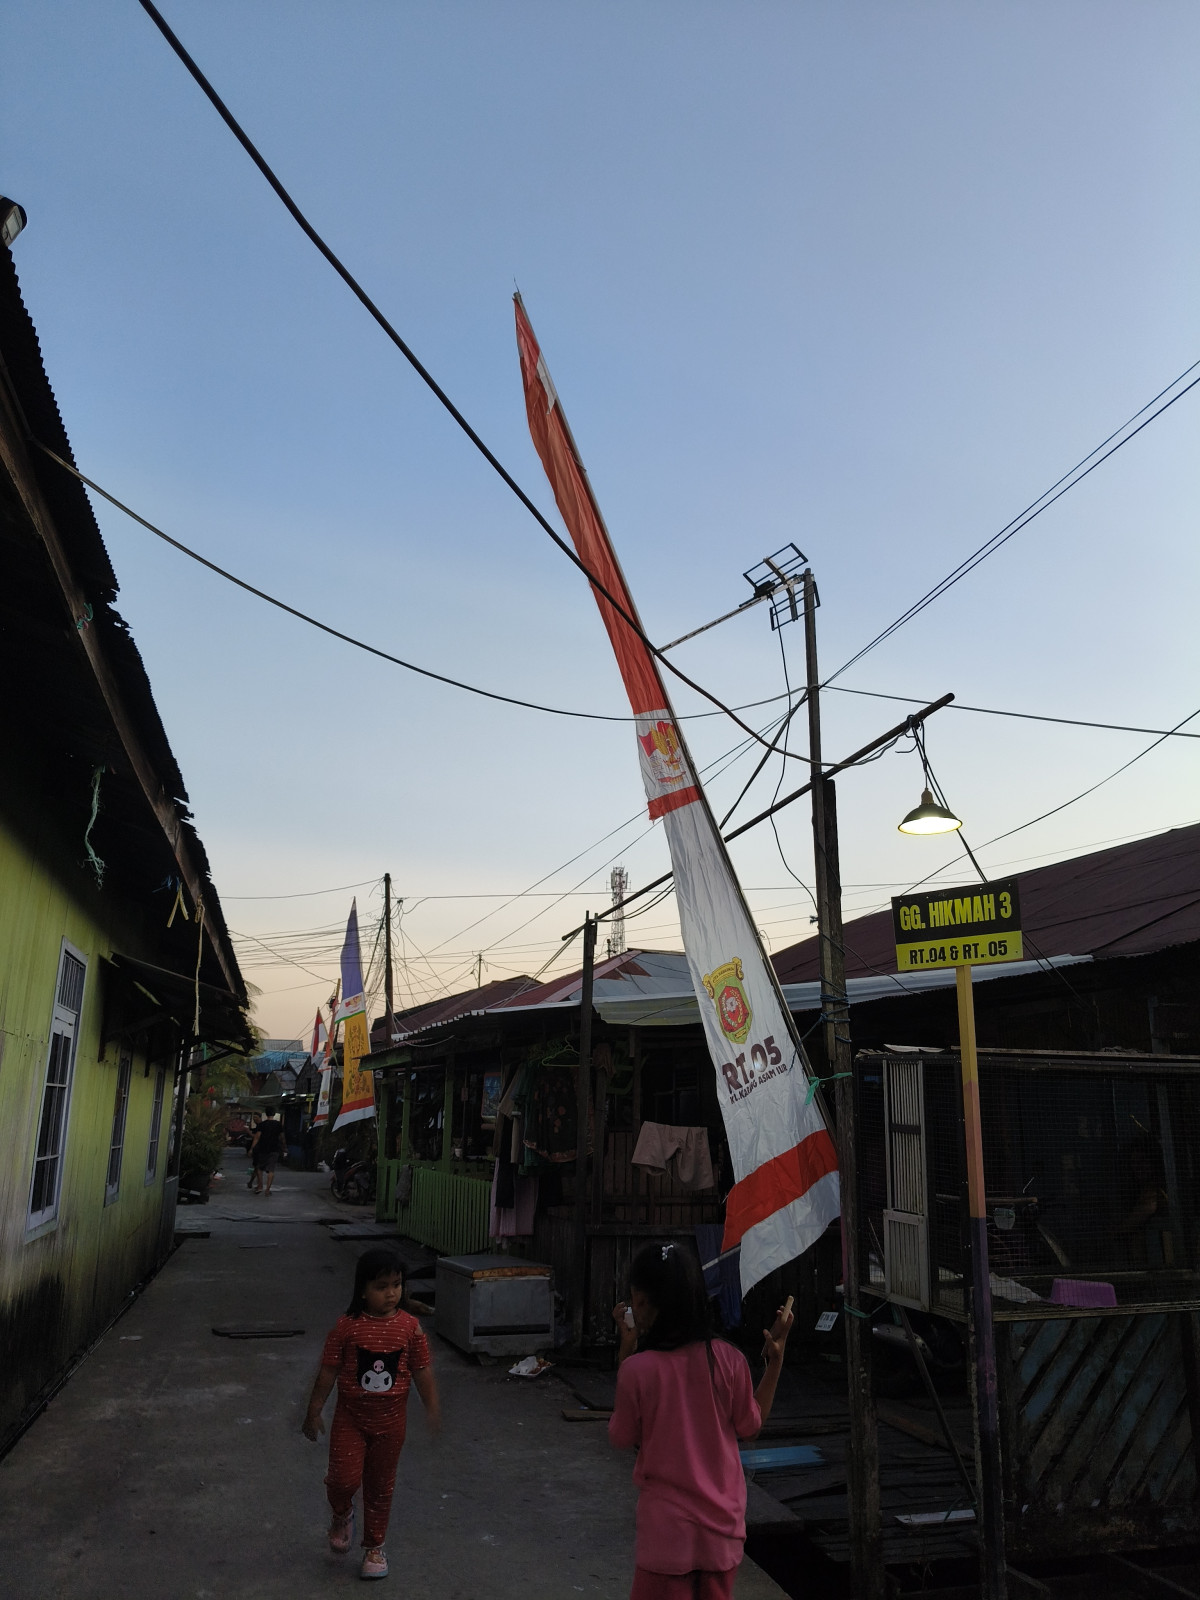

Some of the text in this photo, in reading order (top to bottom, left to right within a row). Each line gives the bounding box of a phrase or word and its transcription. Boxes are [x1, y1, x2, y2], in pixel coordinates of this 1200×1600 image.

[900, 891, 1012, 931] GG. HIKMAH 3
[722, 1035, 782, 1094] RT.05
[758, 1069, 777, 1085] ASAM
